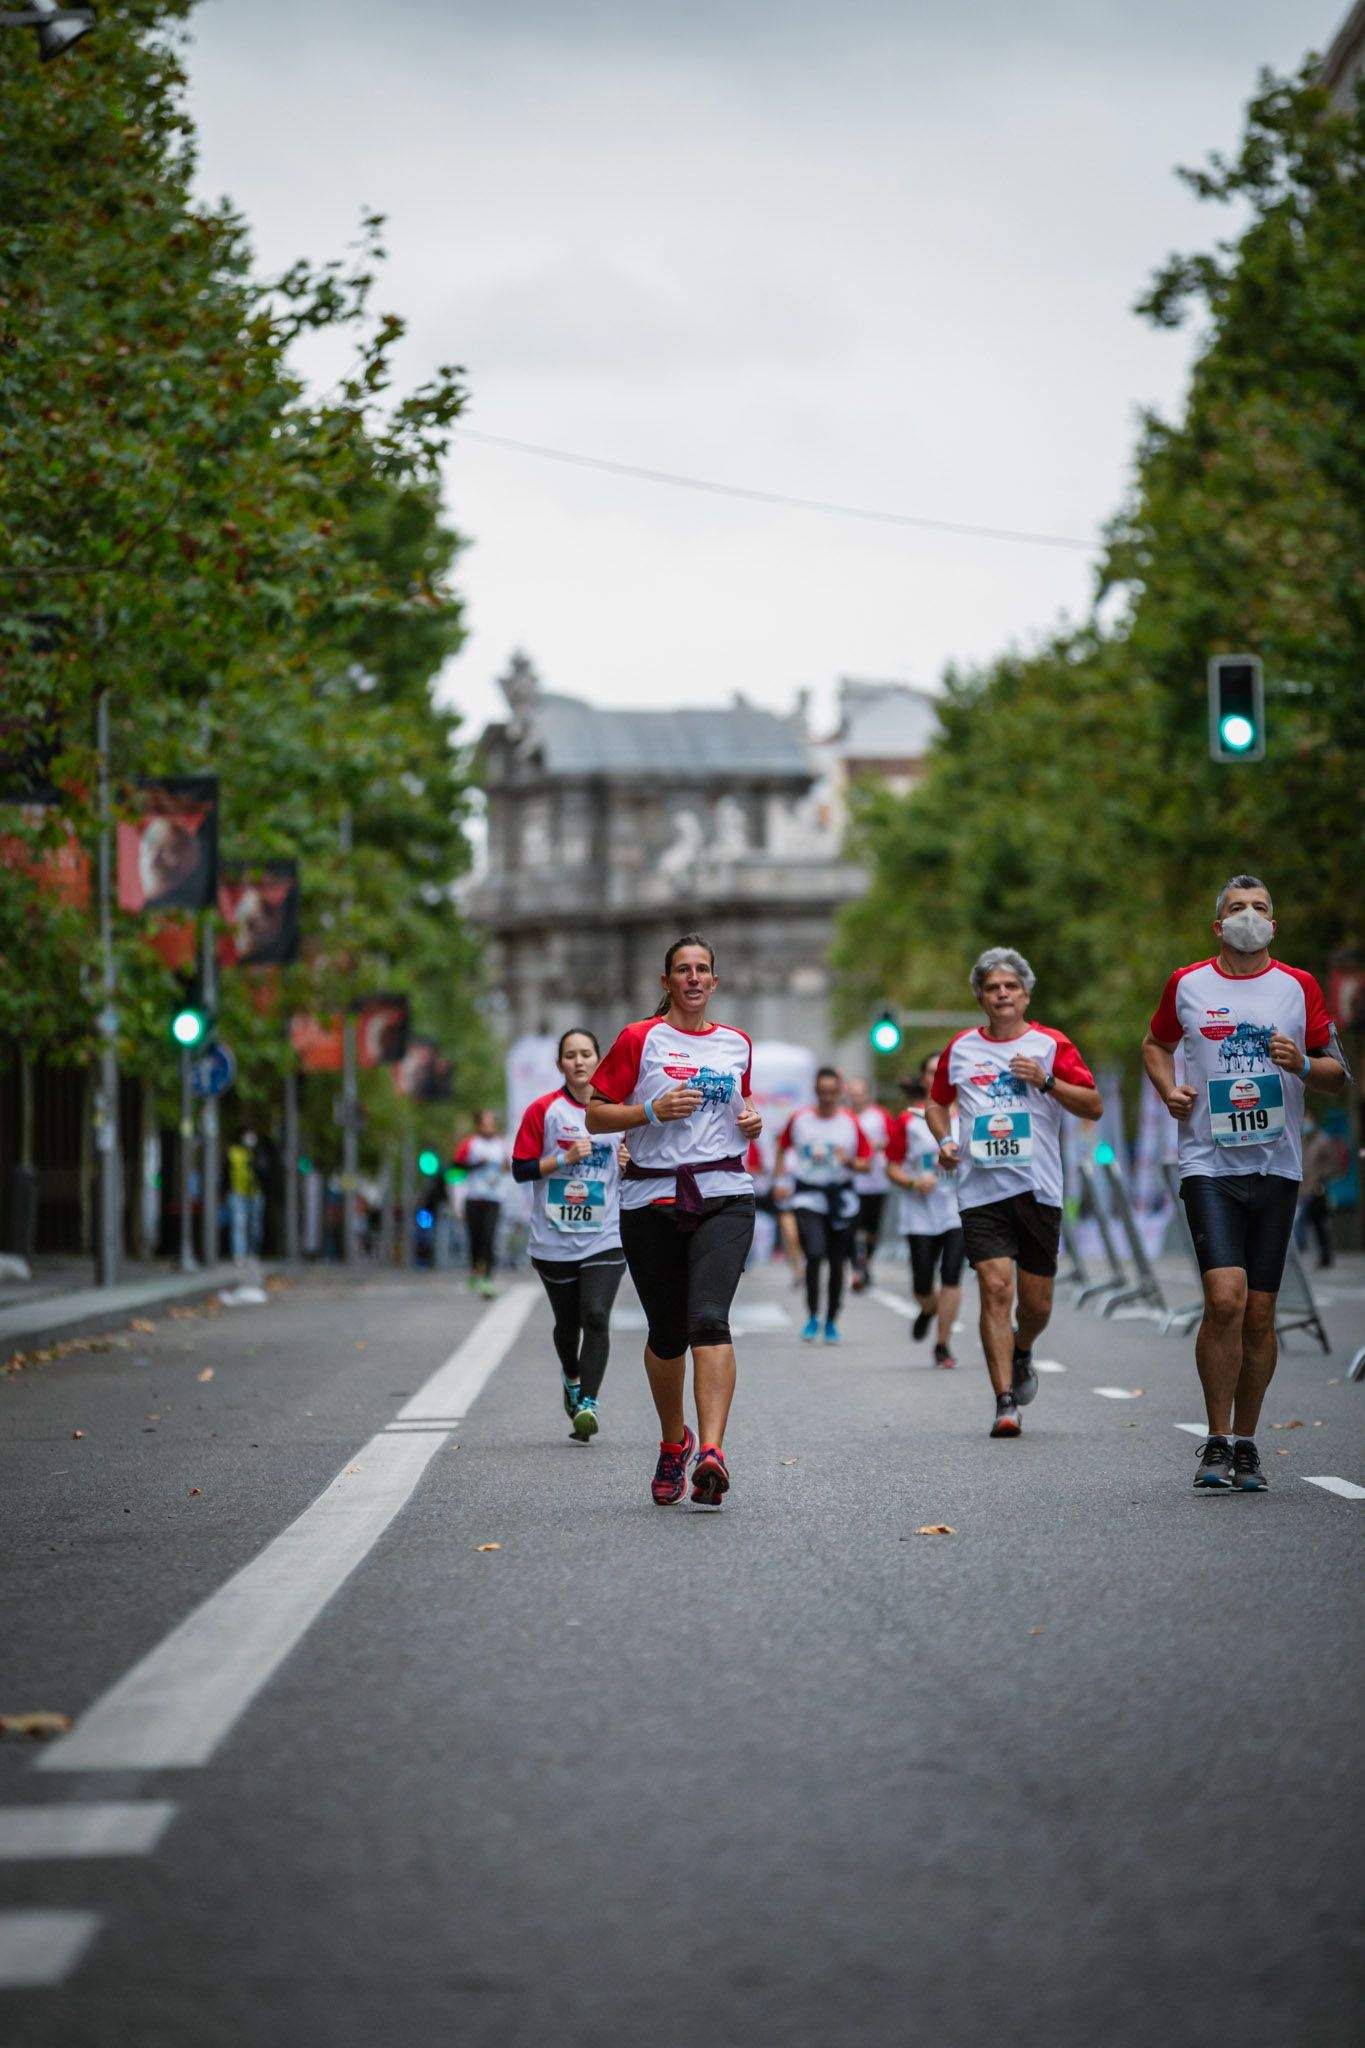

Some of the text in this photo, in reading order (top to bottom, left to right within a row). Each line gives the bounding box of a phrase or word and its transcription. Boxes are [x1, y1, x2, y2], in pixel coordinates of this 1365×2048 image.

[1228, 1110, 1269, 1132] 1119
[985, 1140, 1020, 1156] 1135
[559, 1206, 592, 1222] 1126
